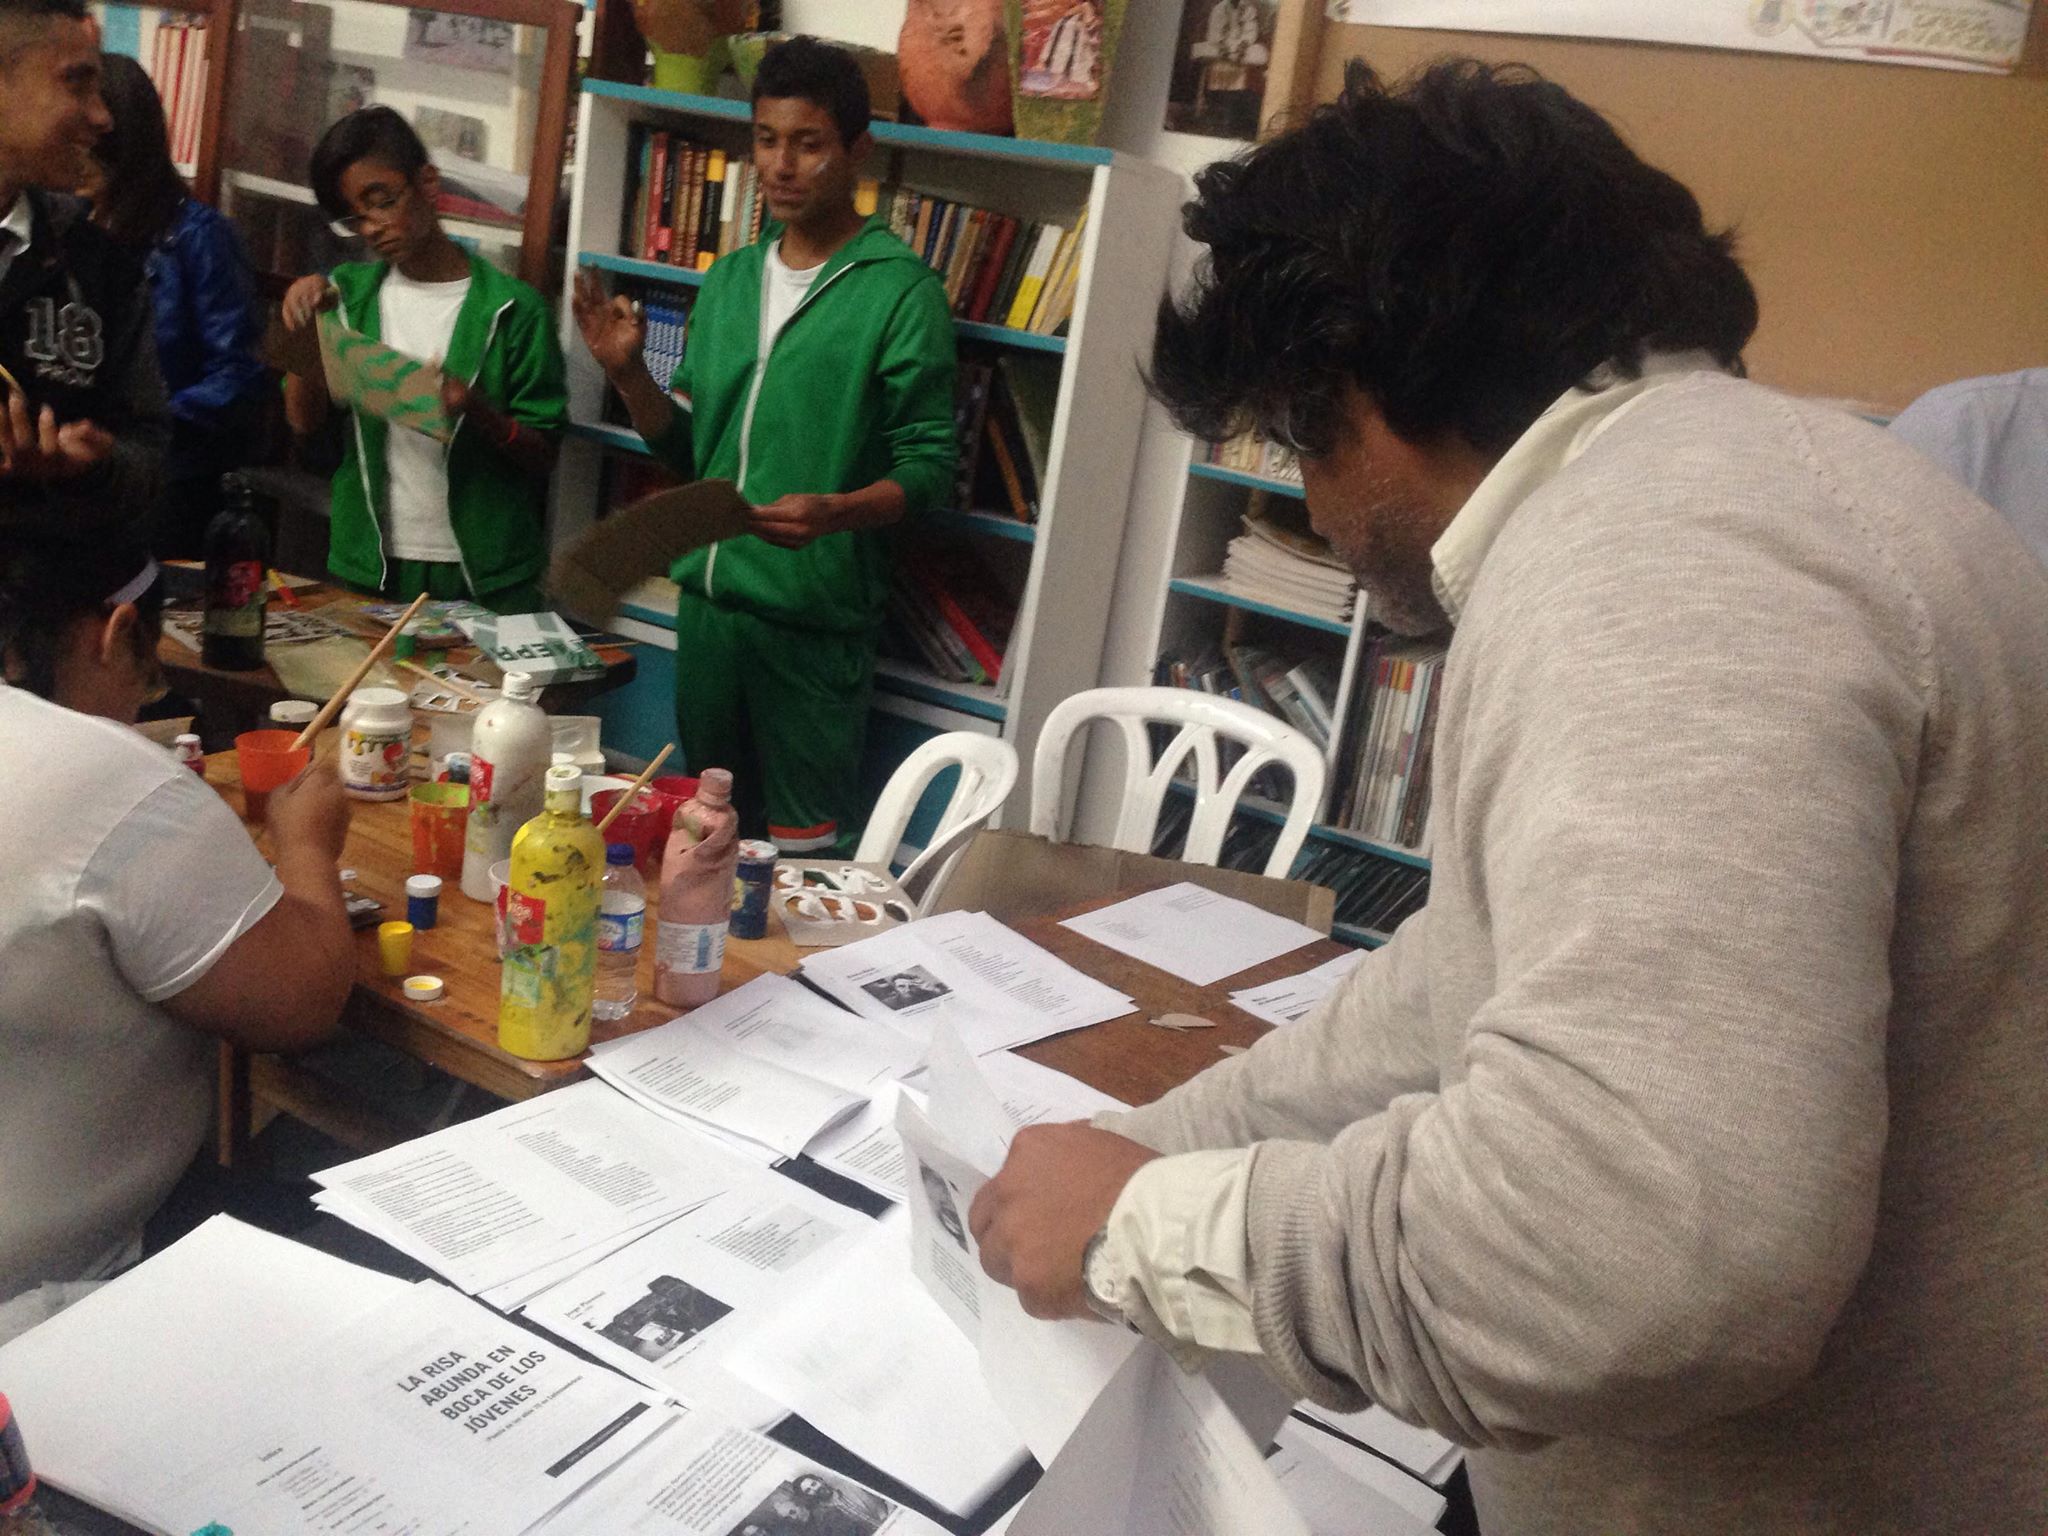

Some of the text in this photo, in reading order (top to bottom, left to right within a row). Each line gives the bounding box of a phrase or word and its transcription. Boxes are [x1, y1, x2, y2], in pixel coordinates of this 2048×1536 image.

[24, 297, 104, 370] 18
[397, 1350, 467, 1393] LA RISA
[420, 1345, 516, 1406] ABUNDA EN
[440, 1350, 547, 1420] BOCA DE LOS
[463, 1384, 538, 1434] JÓVENES
